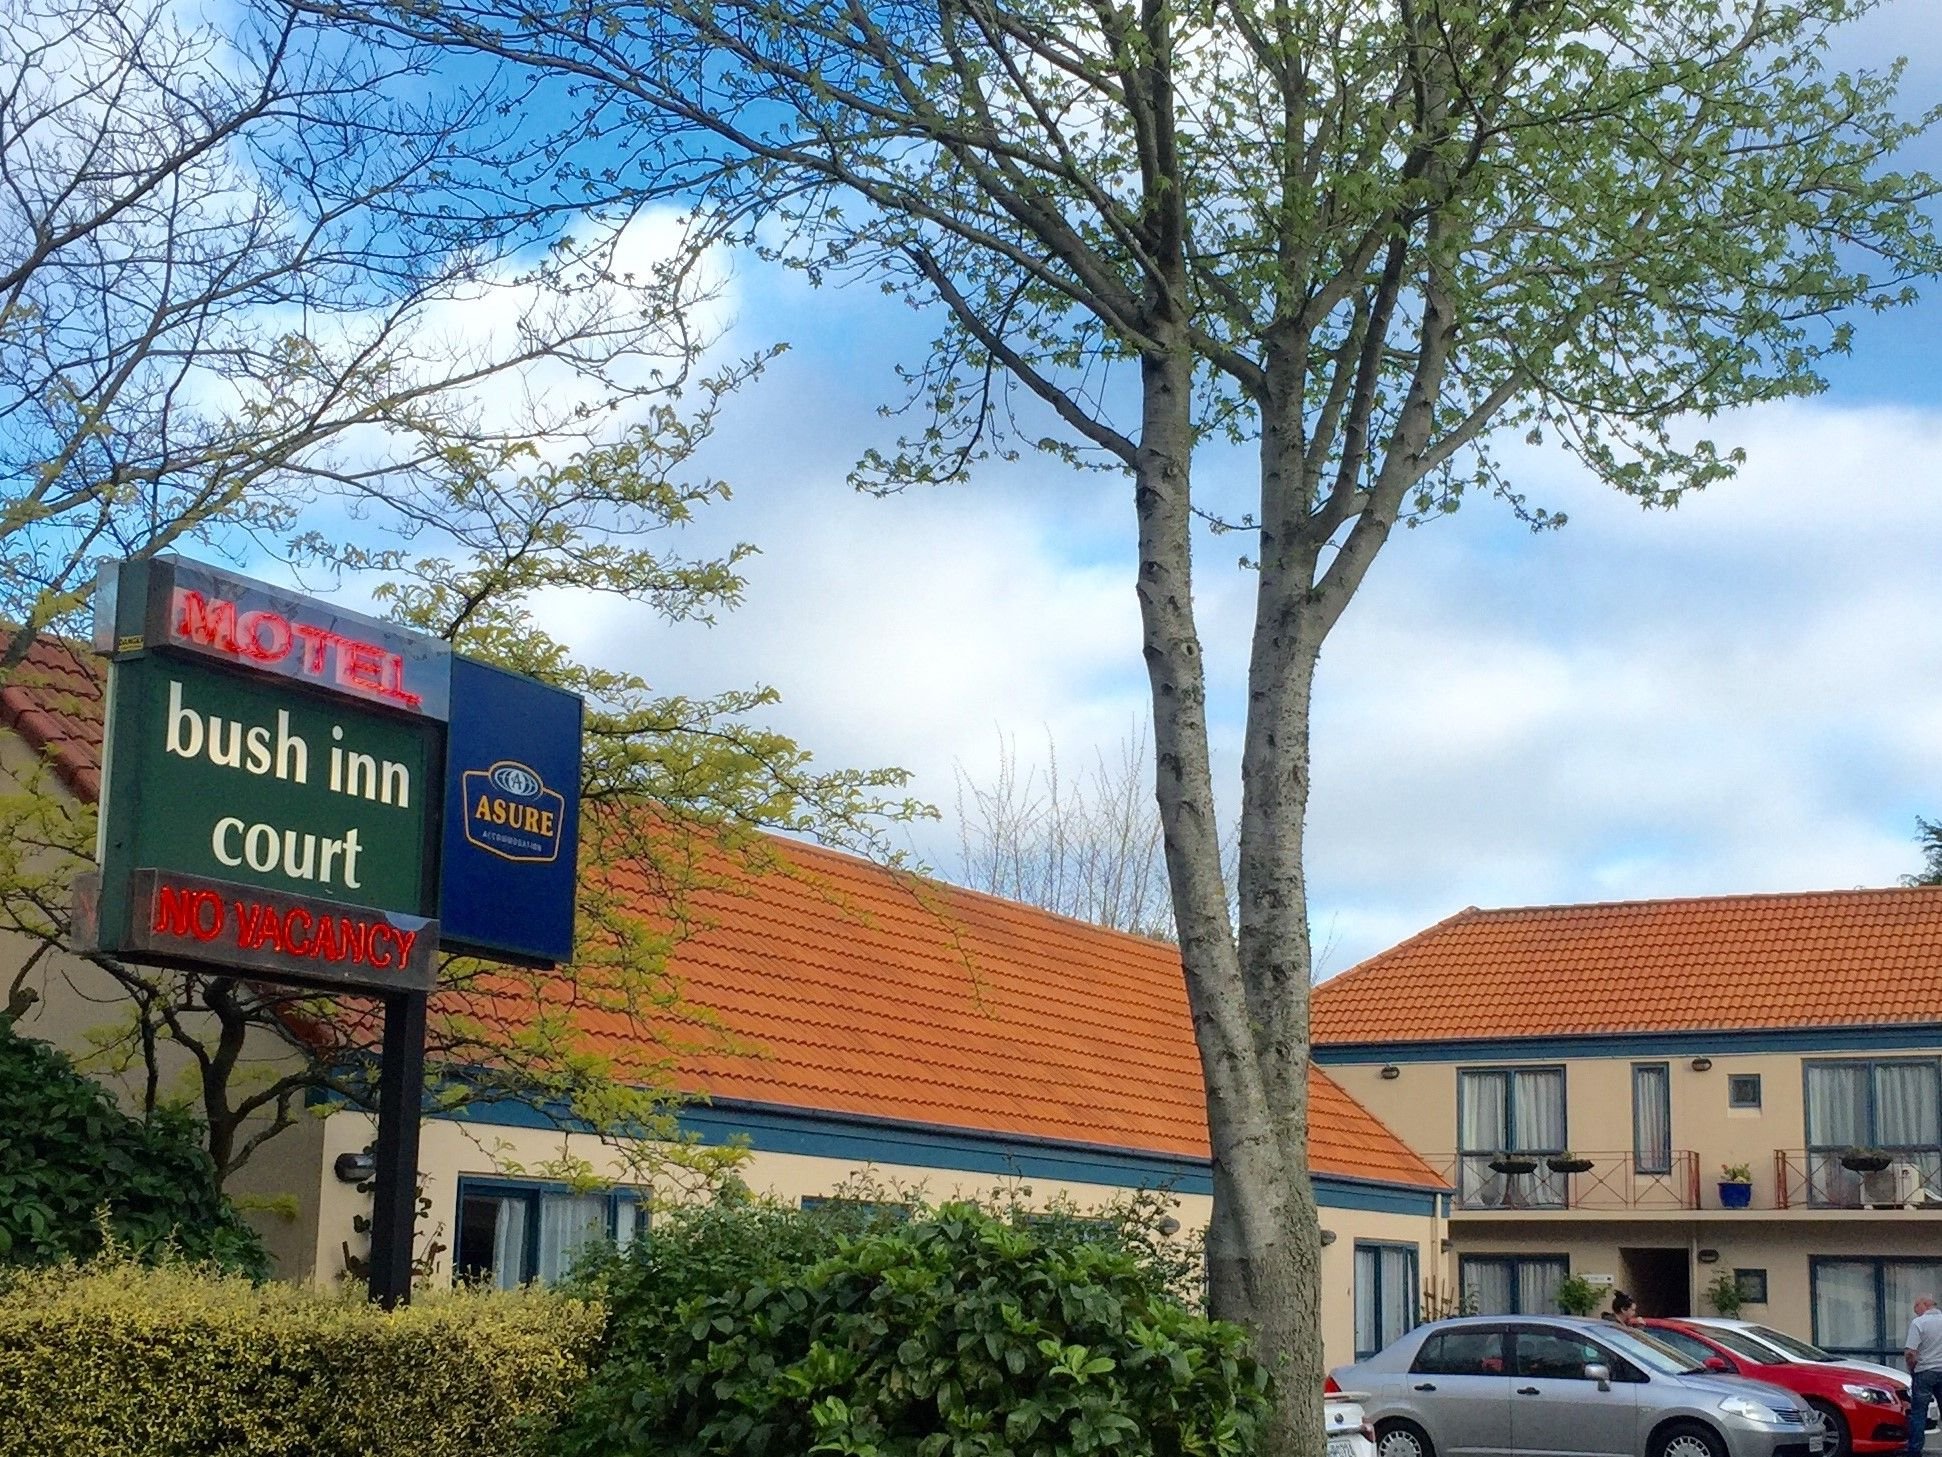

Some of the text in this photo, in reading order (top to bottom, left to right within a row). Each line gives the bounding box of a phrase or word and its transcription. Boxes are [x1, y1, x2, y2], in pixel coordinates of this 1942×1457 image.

[172, 588, 424, 706] MOTEL
[166, 680, 410, 808] bush inn
[212, 817, 363, 889] court
[475, 794, 554, 837] ASURE
[153, 884, 417, 970] NO VACANCY
